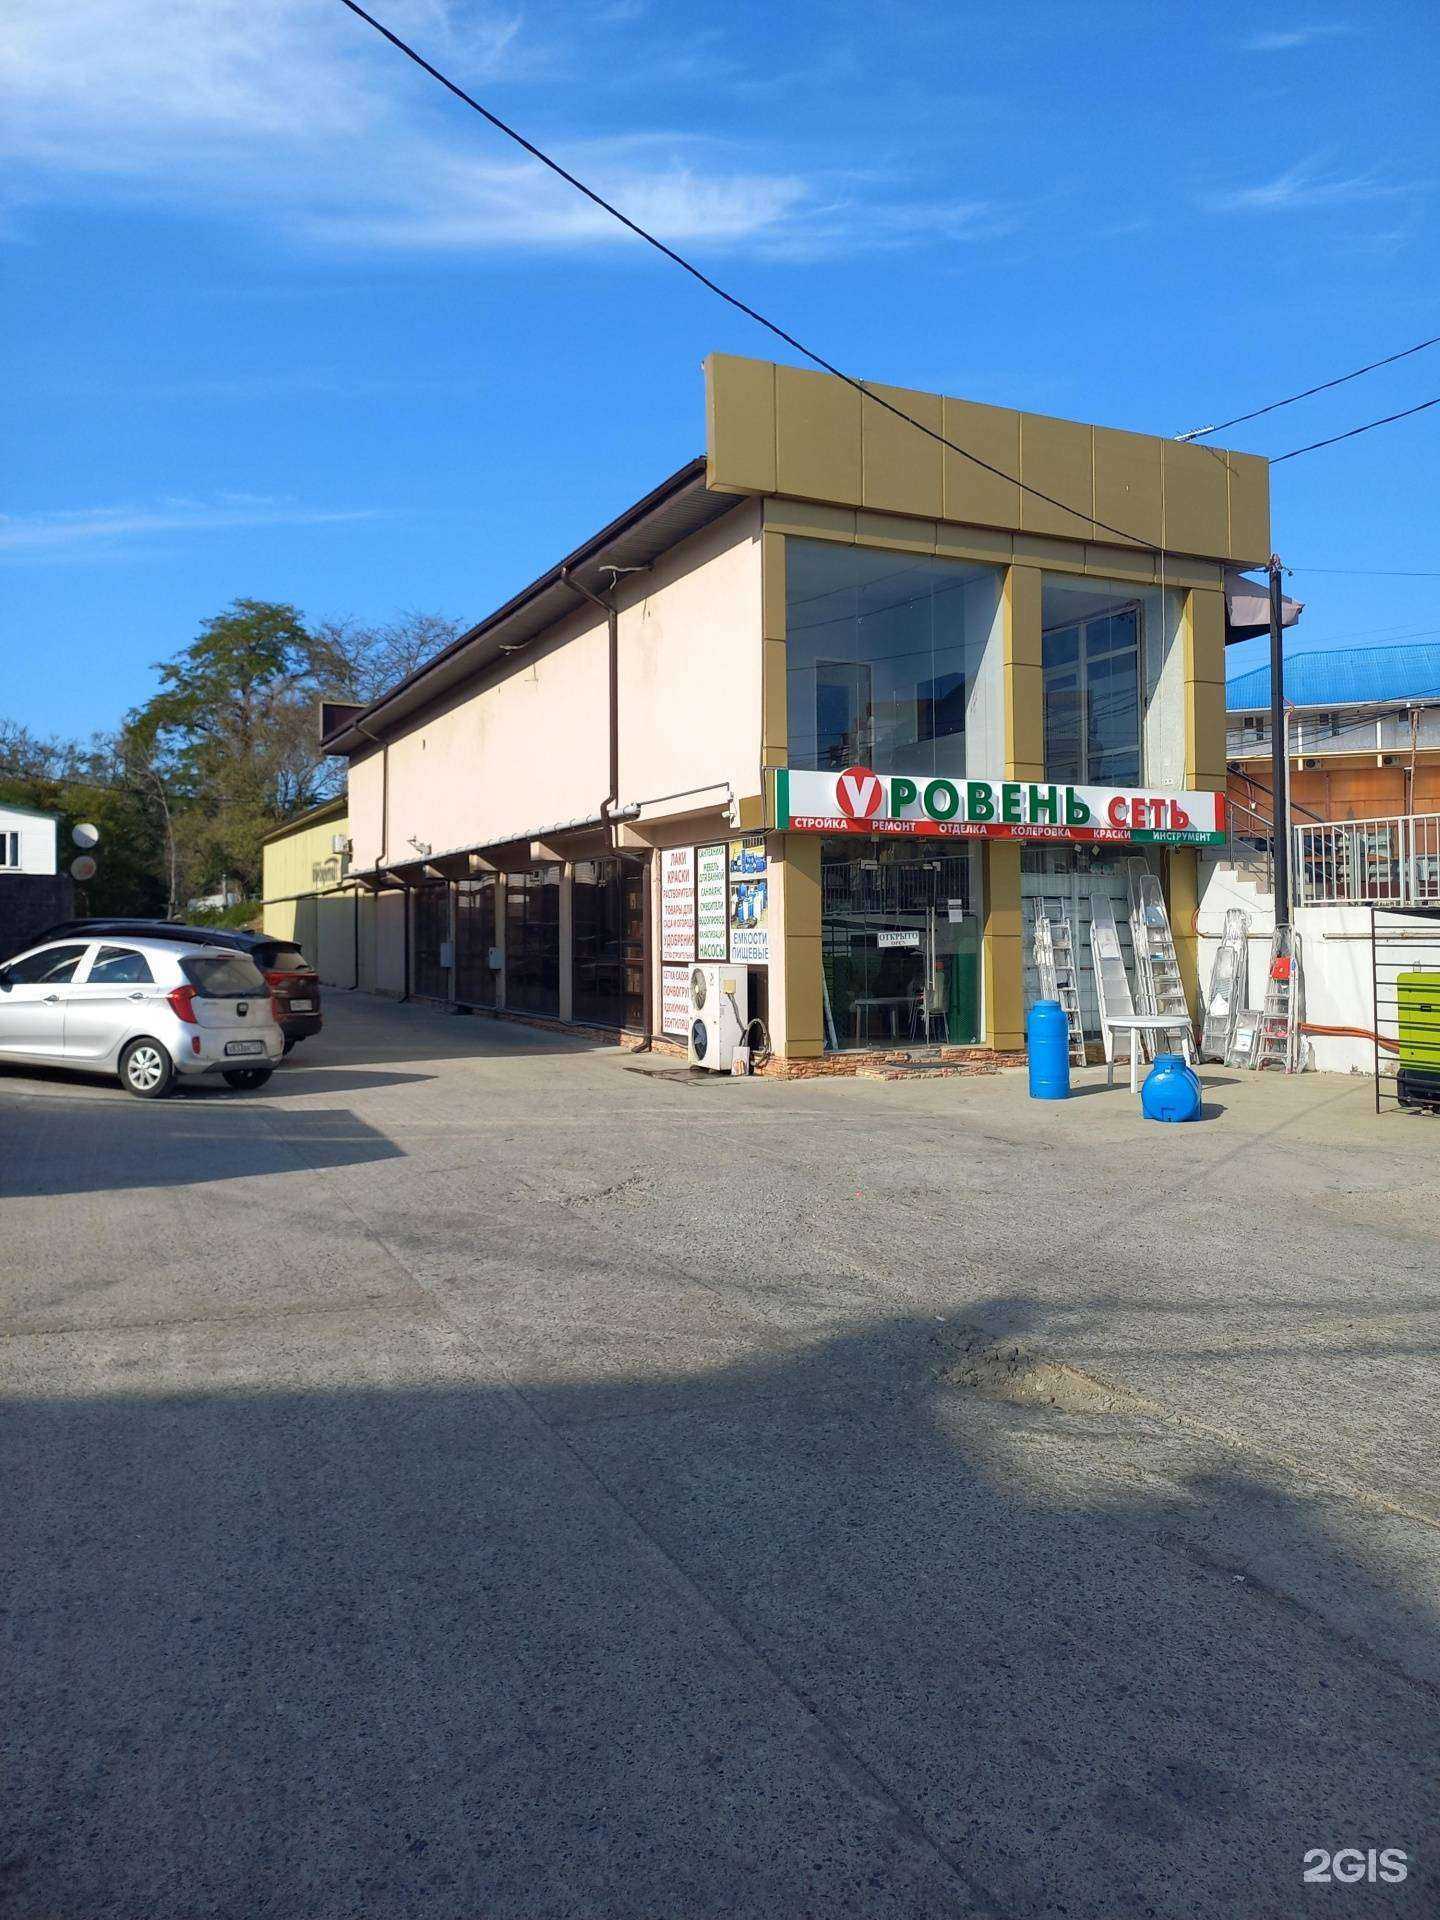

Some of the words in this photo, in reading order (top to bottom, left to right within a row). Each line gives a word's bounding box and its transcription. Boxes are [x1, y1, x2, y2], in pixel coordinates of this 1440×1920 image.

[1107, 795, 1190, 830] СЕТЬ
[794, 816, 848, 830] СТРОЙКА
[872, 820, 916, 832] РЕМОНТ
[939, 823, 988, 836] ОТДЕЛКА
[1010, 825, 1072, 838] КОЛЕРОВКА
[1093, 828, 1131, 840] КРАСКИ
[1153, 831, 1212, 842] ИНСТРУМЕНТ
[667, 869, 690, 883] КРАСКИ
[733, 932, 768, 945] ЕМКОСТИ
[879, 932, 918, 942] ОТКРЫТО
[699, 943, 725, 958] НАСОСЫ
[731, 946, 769, 961] ПИЩЕВЫЕ
